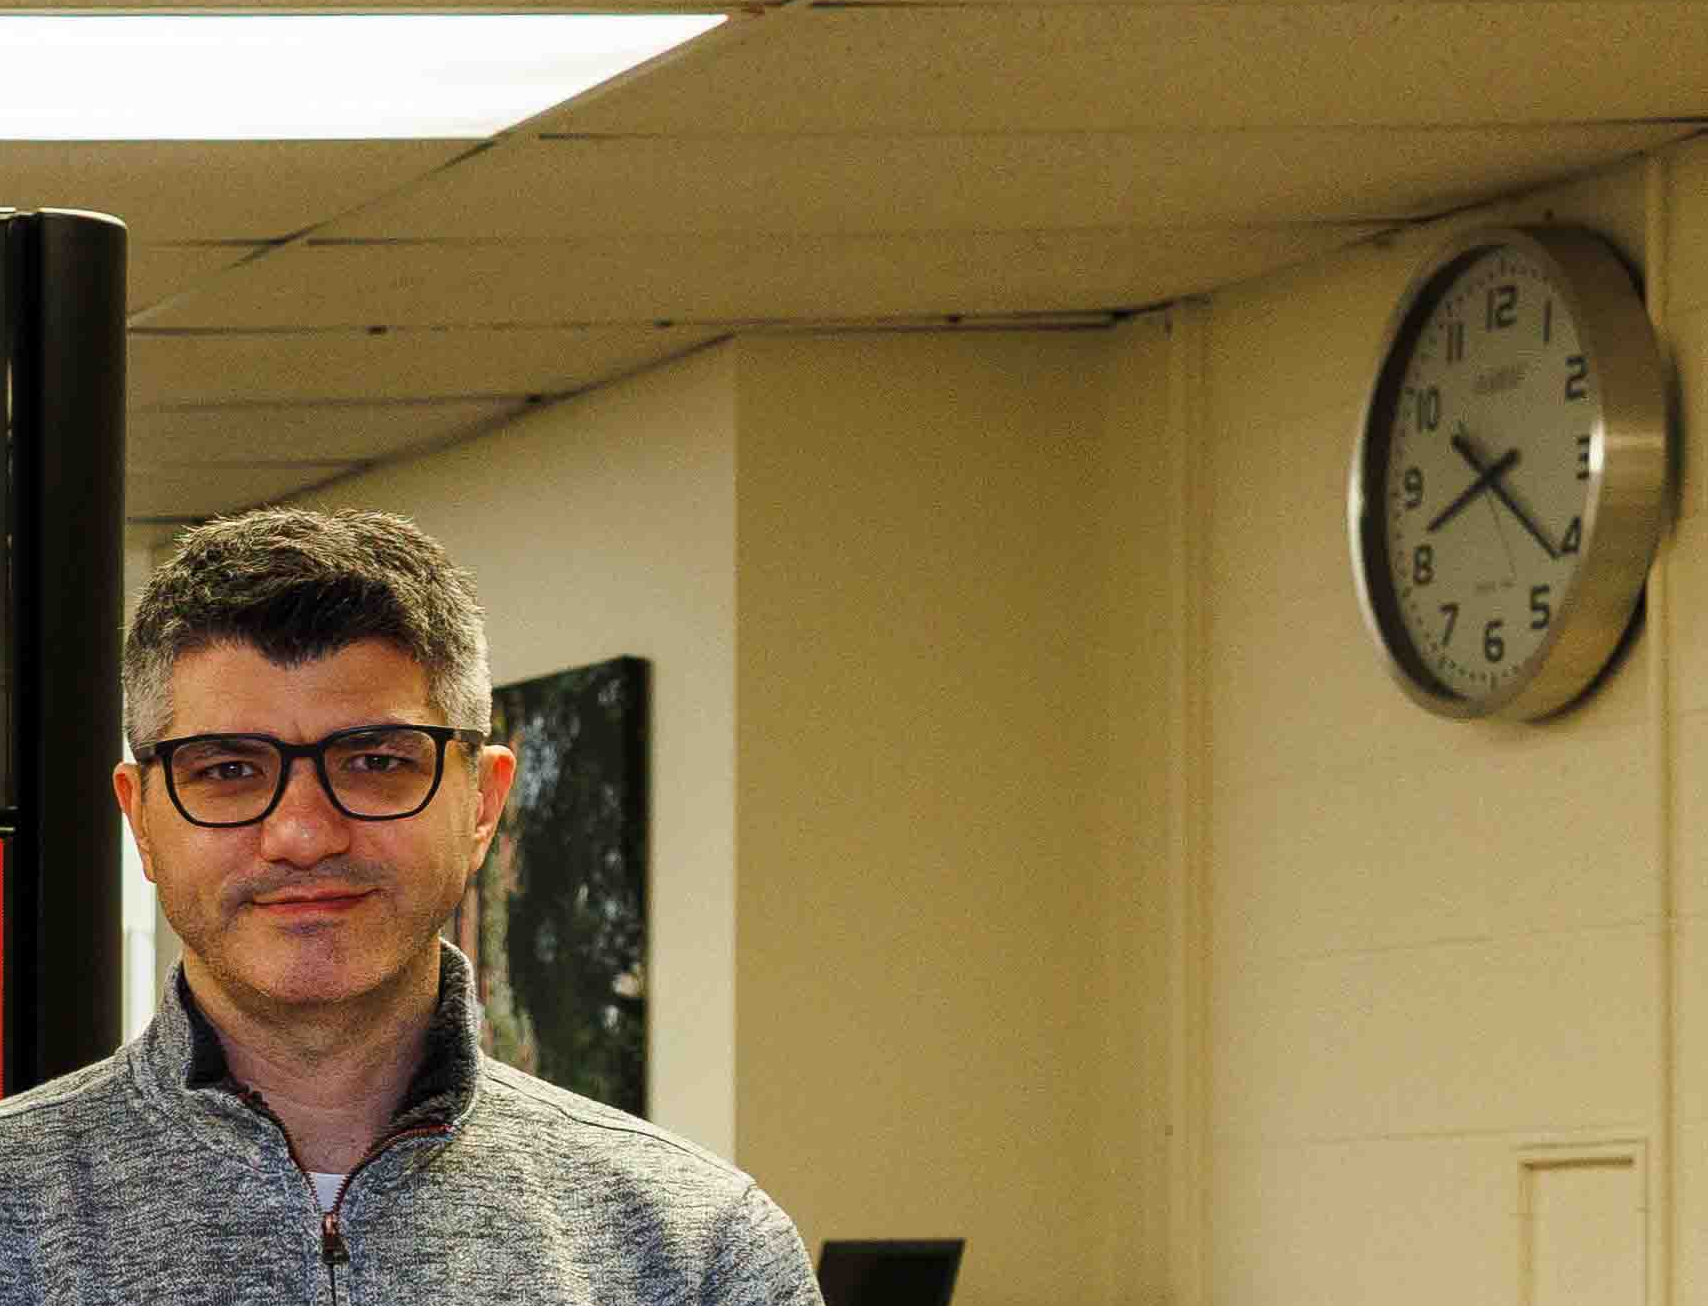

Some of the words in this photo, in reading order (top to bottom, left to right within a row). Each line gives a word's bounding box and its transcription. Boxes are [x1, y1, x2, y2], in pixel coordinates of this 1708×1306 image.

[1485, 285, 1517, 333] 12
[1565, 356, 1588, 402] 2
[1404, 466, 1424, 510] 9
[1413, 544, 1435, 586] 8
[1439, 603, 1460, 647] 7
[1529, 585, 1551, 630] 5
[1483, 620, 1504, 663] 6
